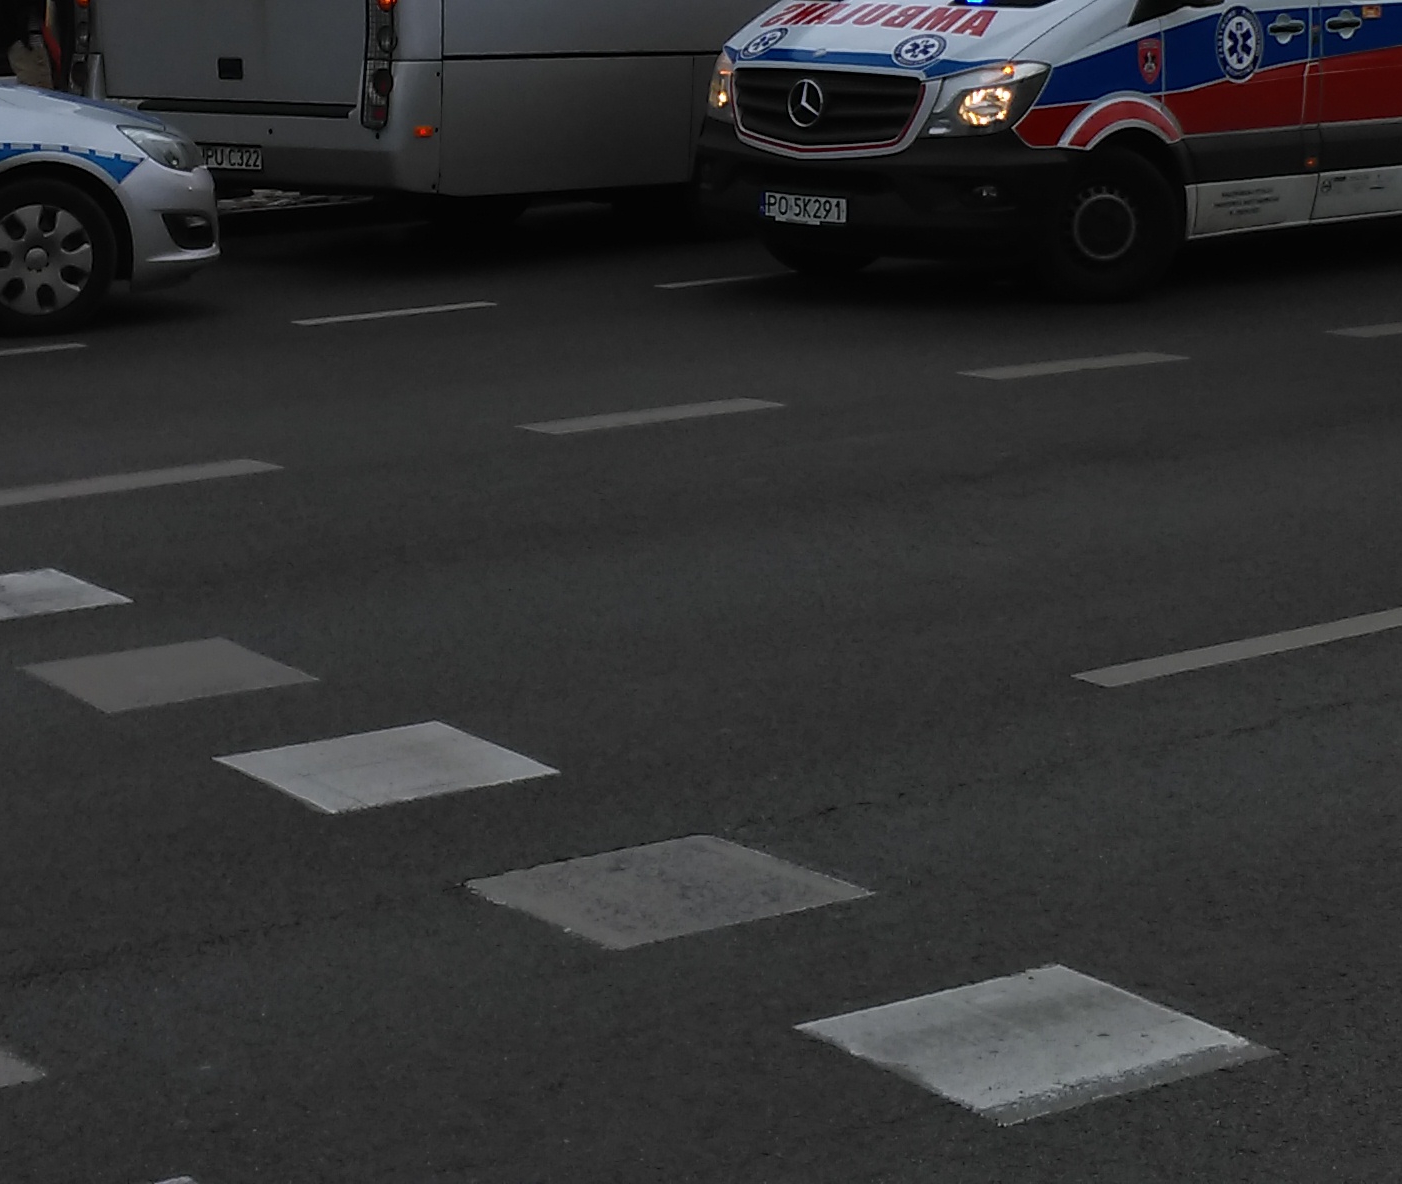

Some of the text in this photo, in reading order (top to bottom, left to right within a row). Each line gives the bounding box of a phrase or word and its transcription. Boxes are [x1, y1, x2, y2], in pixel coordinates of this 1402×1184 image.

[202, 148, 260, 168] PU C322
[767, 194, 841, 221] PO 5K291
